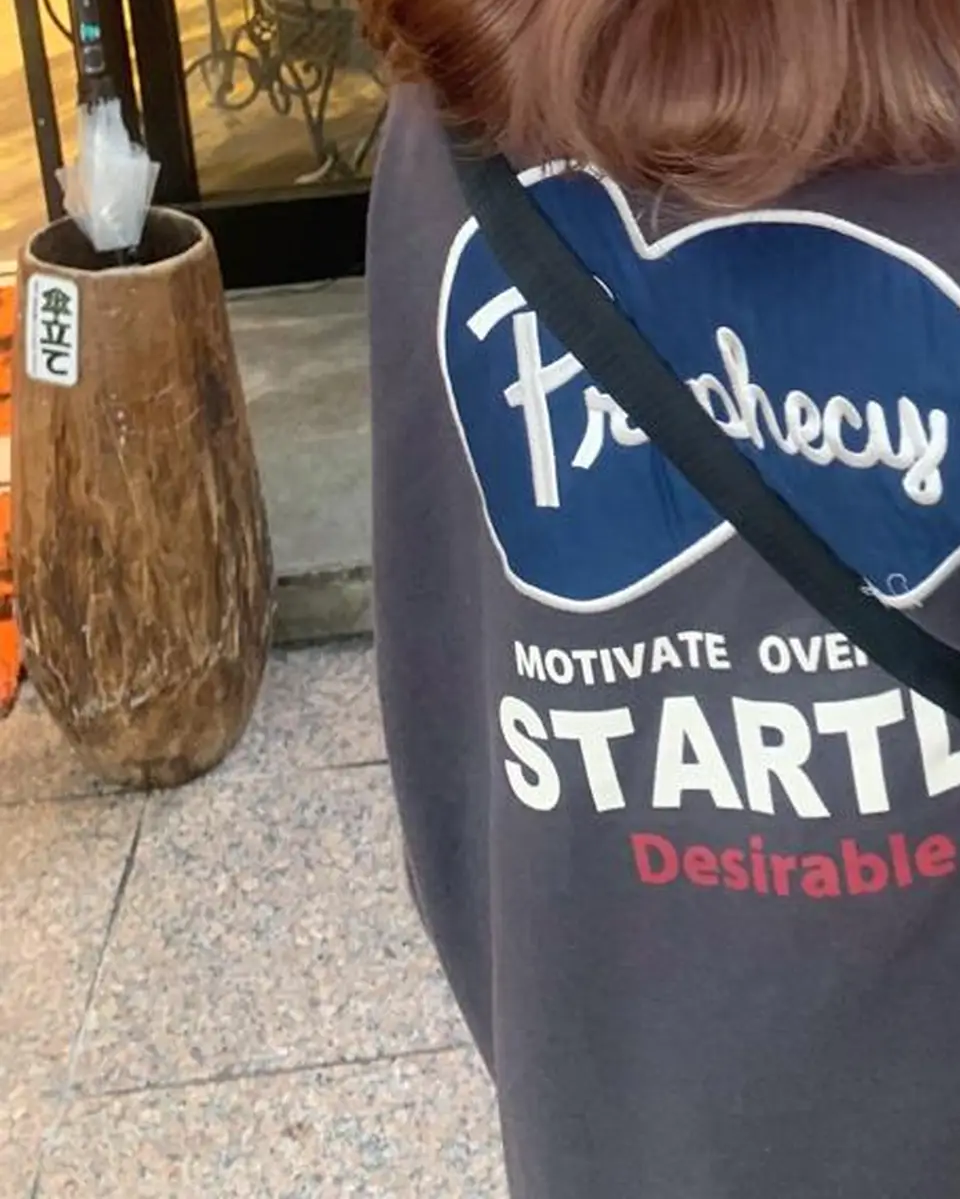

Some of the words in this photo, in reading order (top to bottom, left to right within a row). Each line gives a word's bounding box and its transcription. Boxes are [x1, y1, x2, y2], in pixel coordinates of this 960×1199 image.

[40, 287, 72, 376] 傘立て
[514, 630, 732, 685] MOTIVATE
[630, 833, 957, 896] Desirable
